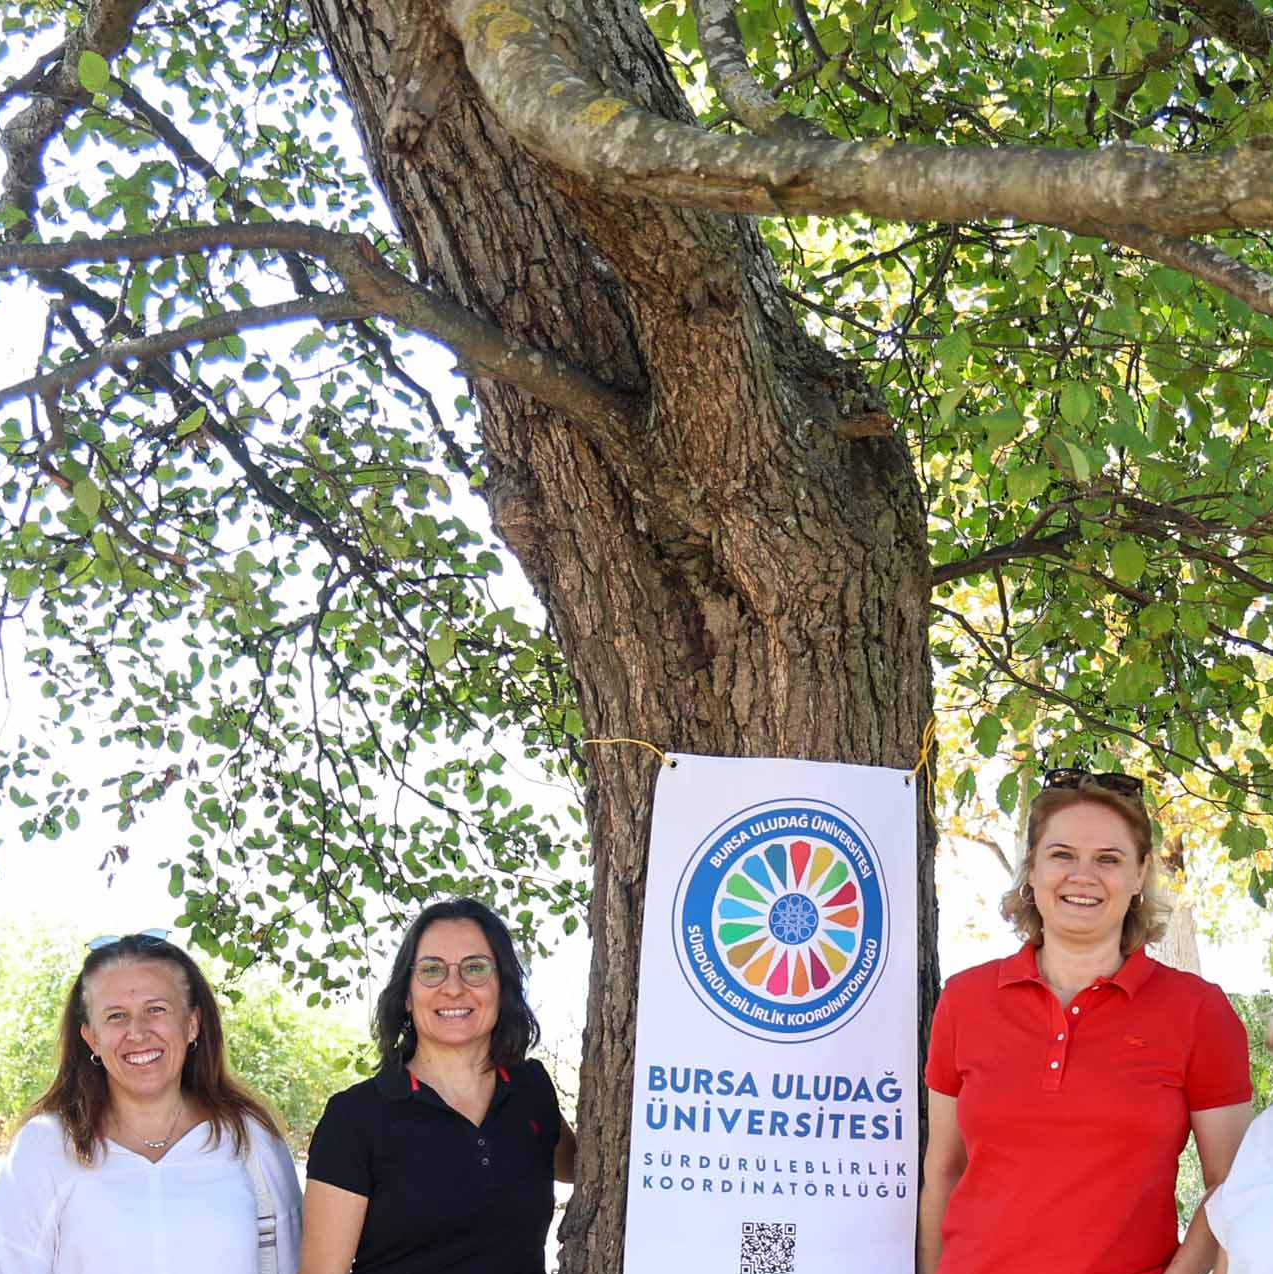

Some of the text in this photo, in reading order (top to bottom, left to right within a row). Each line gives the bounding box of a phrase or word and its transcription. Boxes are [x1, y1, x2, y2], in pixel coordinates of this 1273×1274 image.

[709, 814, 872, 879] BURSA ULUDAĞ ÜNİVERSİTESİ
[648, 1065, 903, 1103] BURSA ULUDAĞ
[645, 1098, 903, 1140] ÜNİVERSİTESİ
[643, 1176, 907, 1198] KOORDİNATÖRLÜĞÜ
